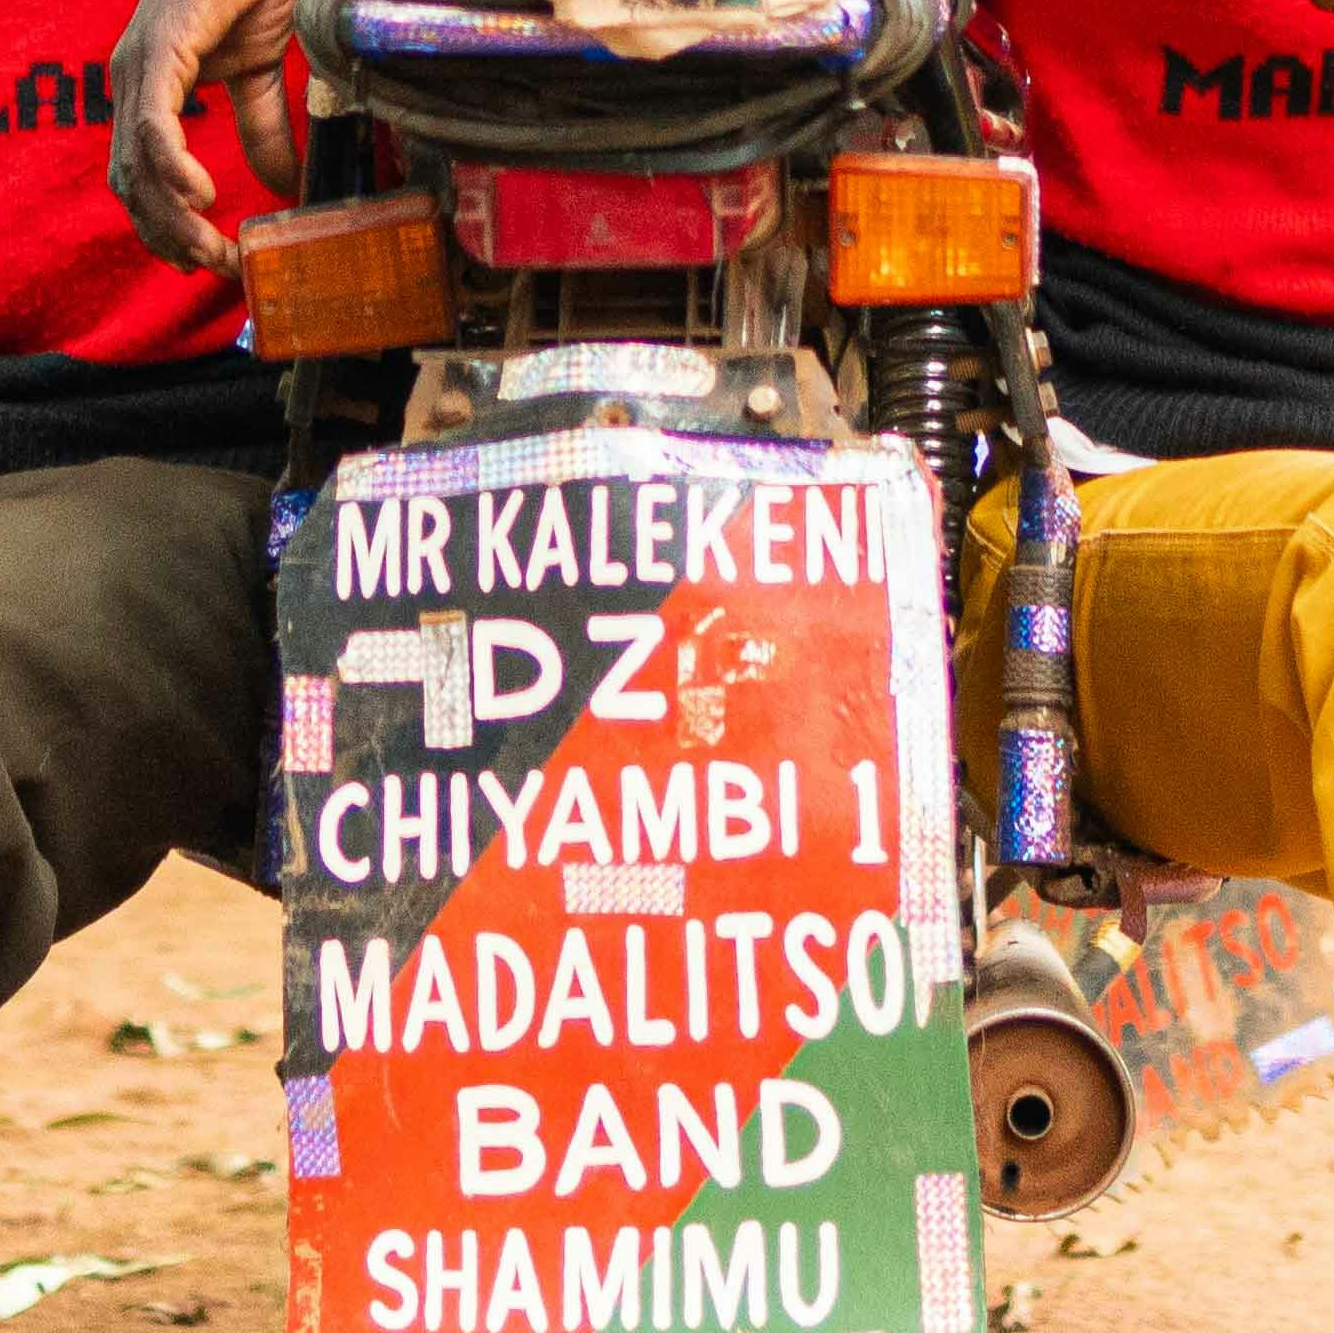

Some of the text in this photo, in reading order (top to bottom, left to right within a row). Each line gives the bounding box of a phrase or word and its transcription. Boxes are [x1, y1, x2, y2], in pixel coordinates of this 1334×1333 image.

[335, 490, 453, 602] MR
[317, 760, 799, 885] CHIYAMBI
[319, 909, 907, 1053] MADALITSO
[1093, 893, 1299, 1049] ALITSO
[457, 1078, 843, 1198] BAND
[365, 1220, 840, 1333] SHAMIMU
